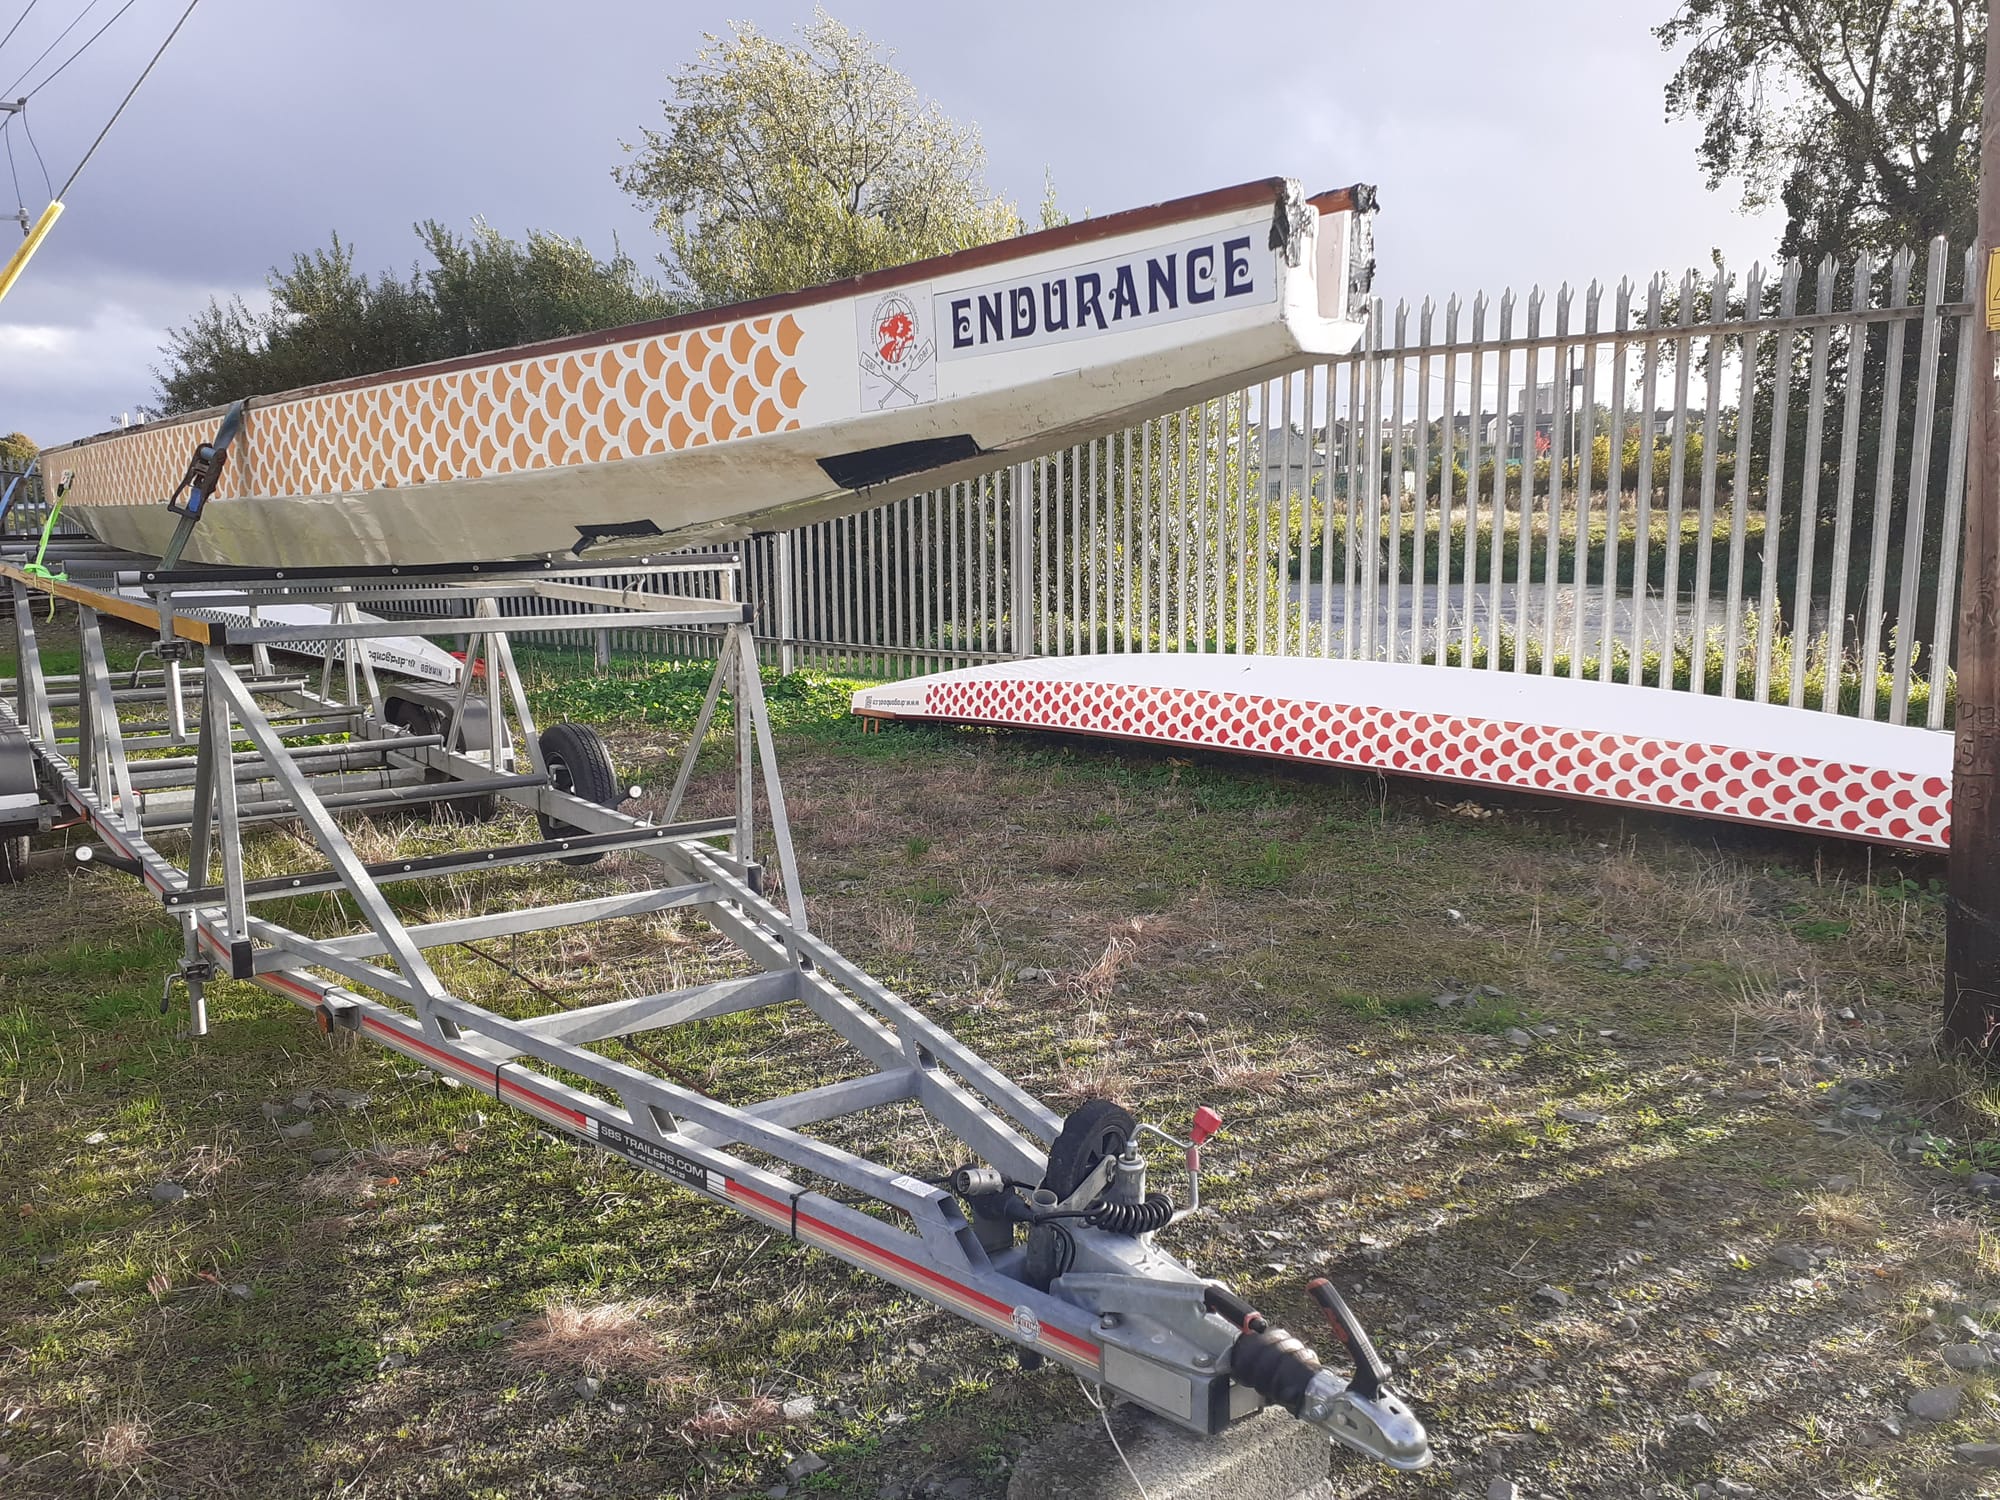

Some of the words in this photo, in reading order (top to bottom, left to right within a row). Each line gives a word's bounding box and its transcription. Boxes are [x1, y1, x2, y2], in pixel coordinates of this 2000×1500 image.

[951, 236, 1253, 349] ENDURANCE
[601, 1126, 621, 1141] SBS
[623, 1135, 704, 1178] TRAILERS.COM
